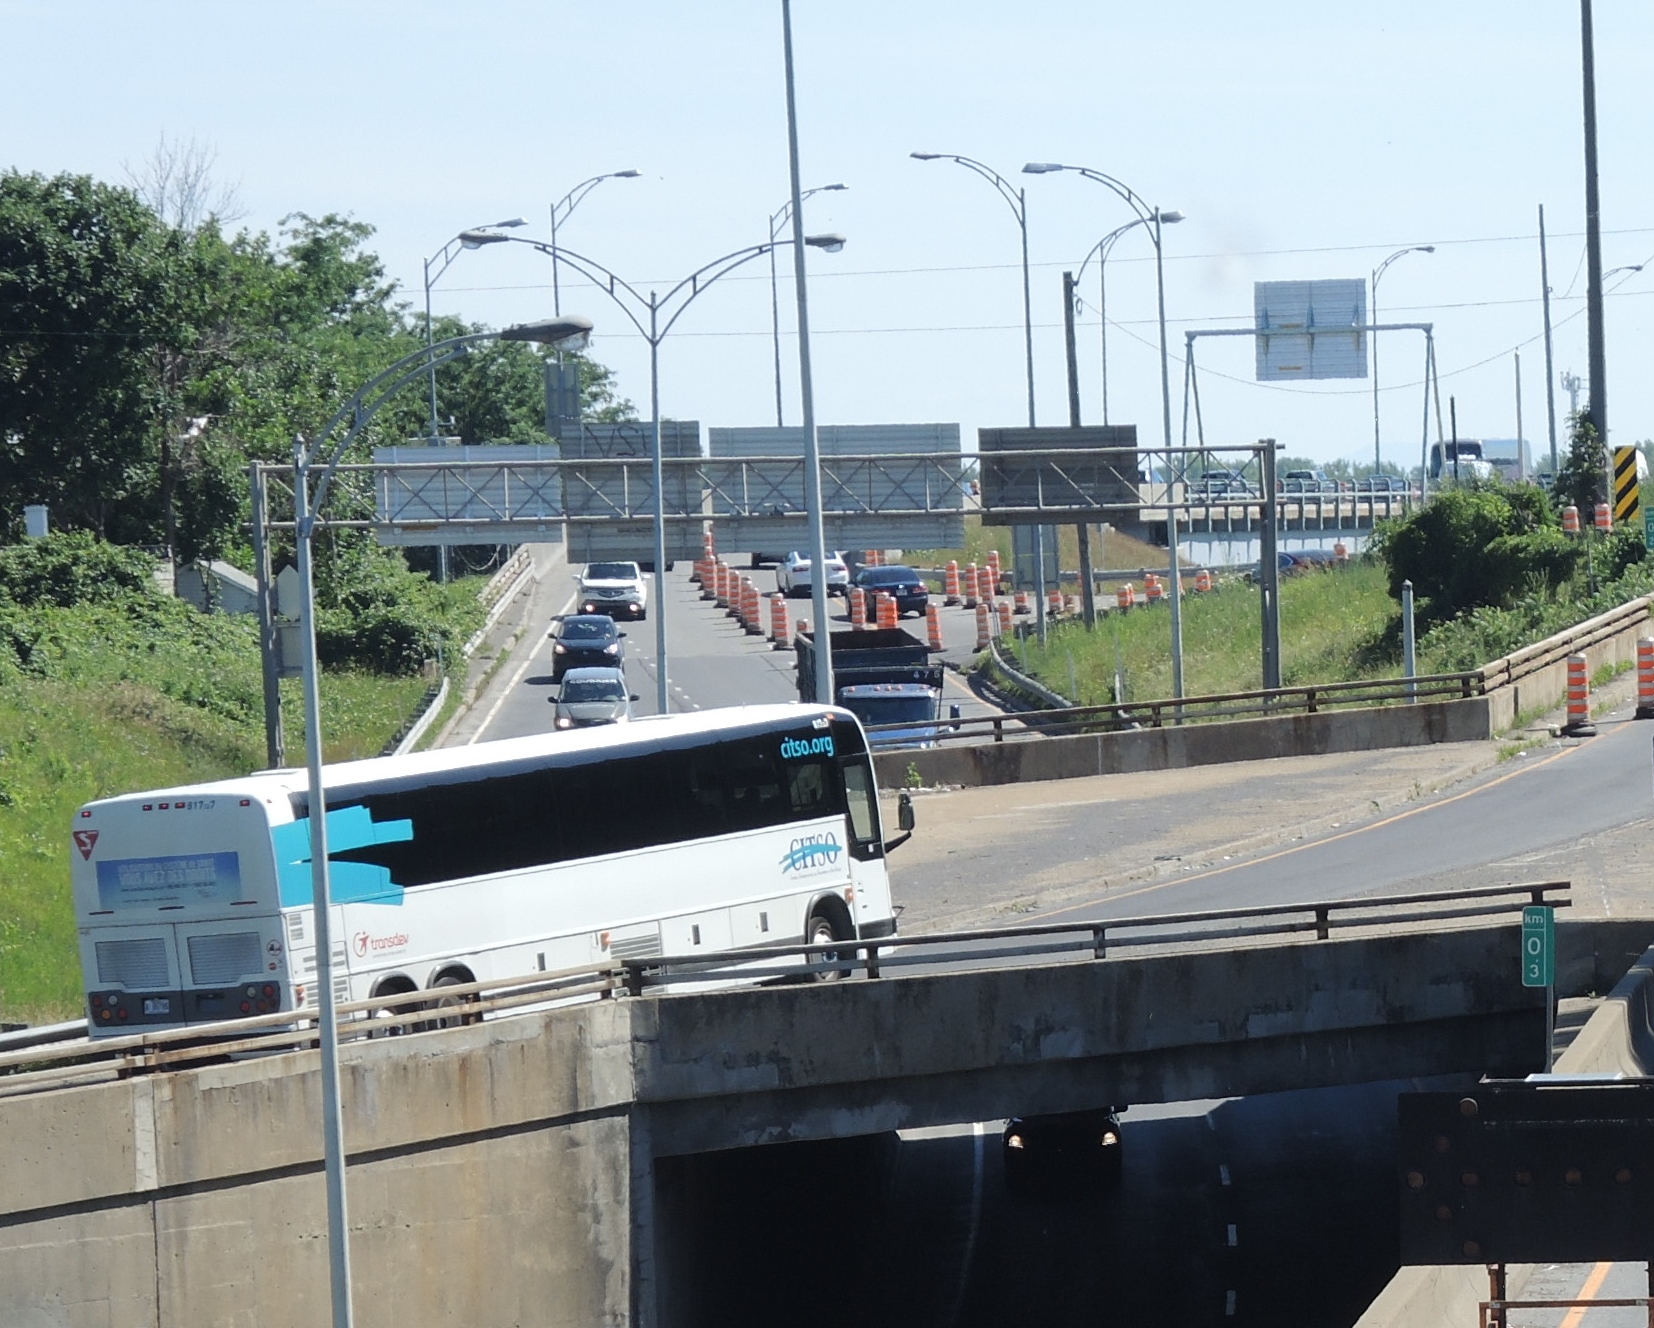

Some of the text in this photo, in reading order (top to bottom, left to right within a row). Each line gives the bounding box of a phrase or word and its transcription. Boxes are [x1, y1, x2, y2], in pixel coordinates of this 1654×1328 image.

[780, 735, 834, 759] citso.org
[790, 831, 838, 871] CITSO
[1524, 914, 1544, 923] km
